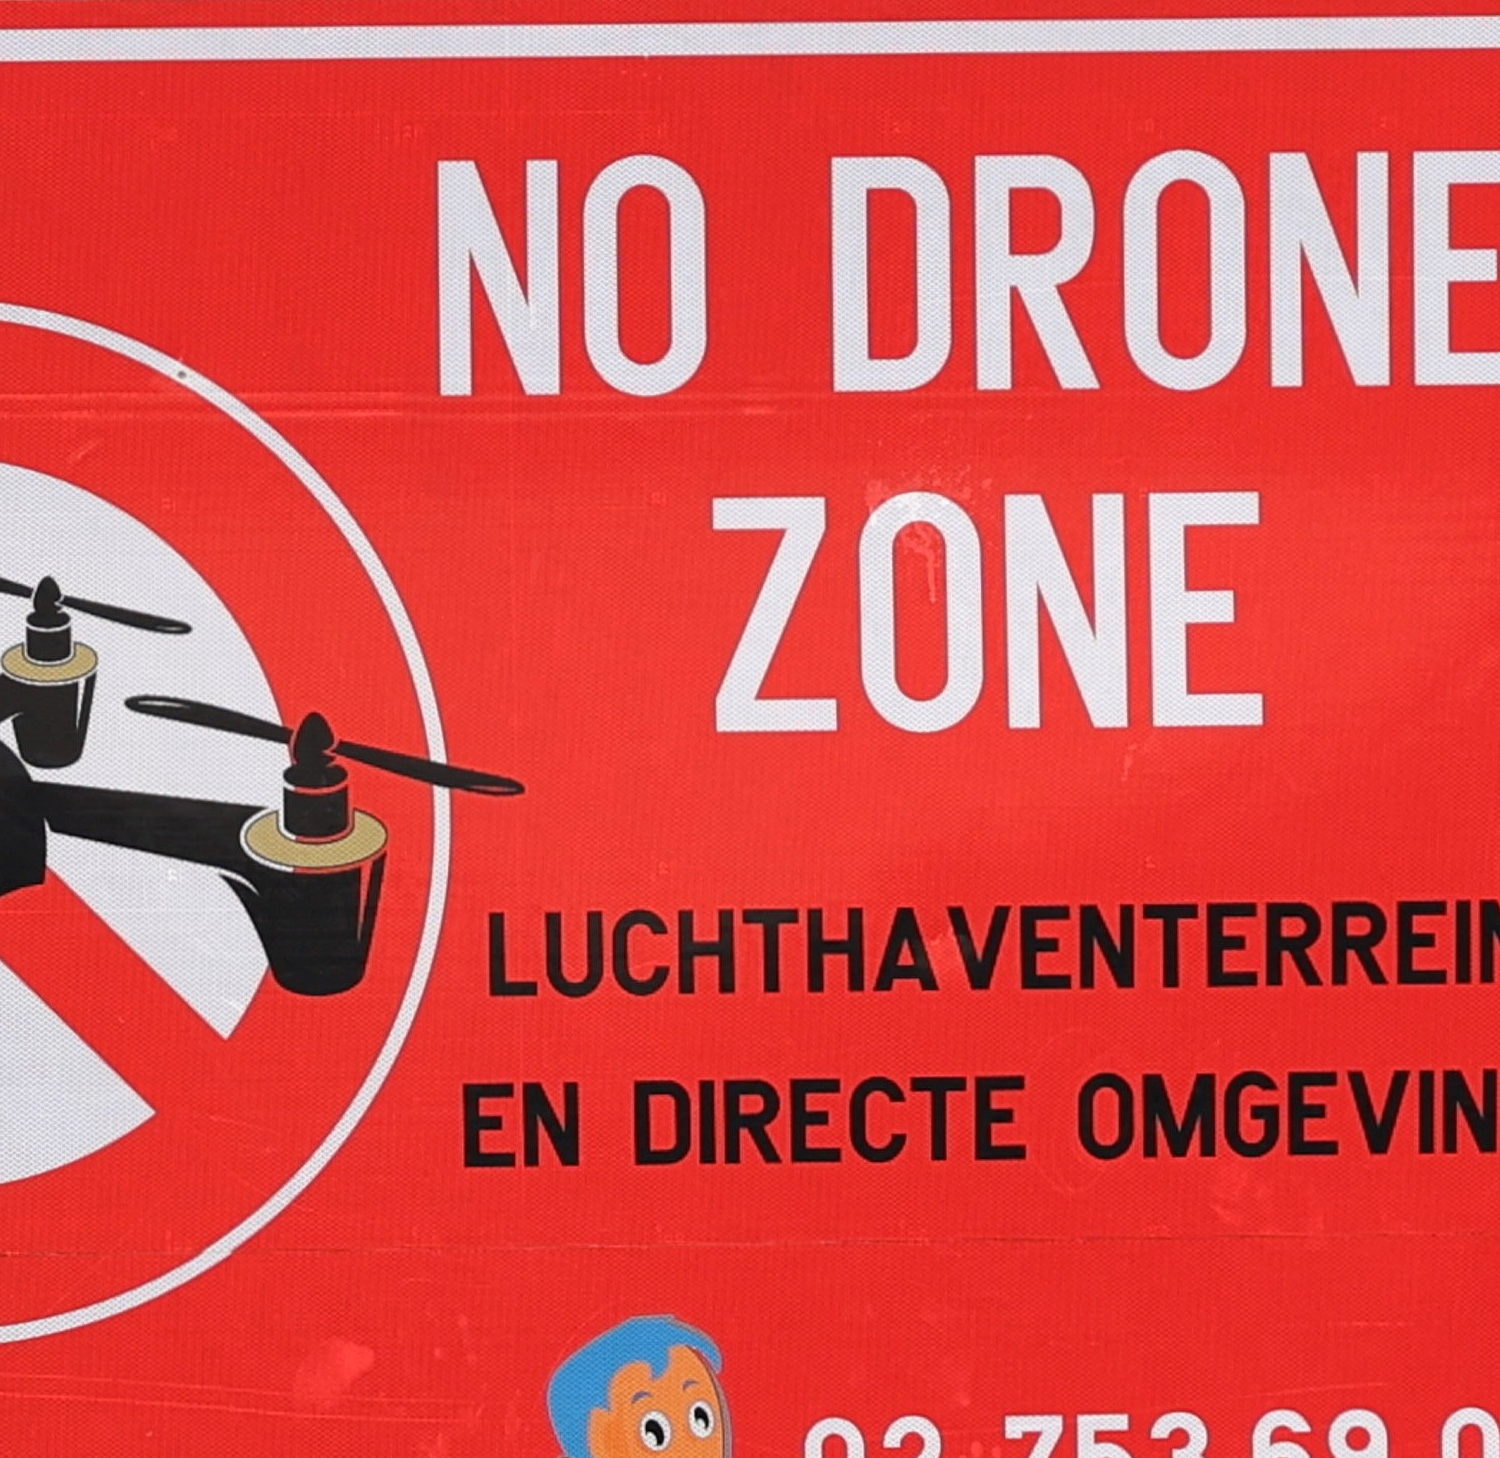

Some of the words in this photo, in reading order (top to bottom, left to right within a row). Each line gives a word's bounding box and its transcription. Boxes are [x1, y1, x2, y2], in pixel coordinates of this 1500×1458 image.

[436, 155, 709, 399] NO
[712, 492, 1266, 735] ZONE
[463, 1083, 582, 1170] EN
[634, 1076, 1028, 1168] DIRECTE
